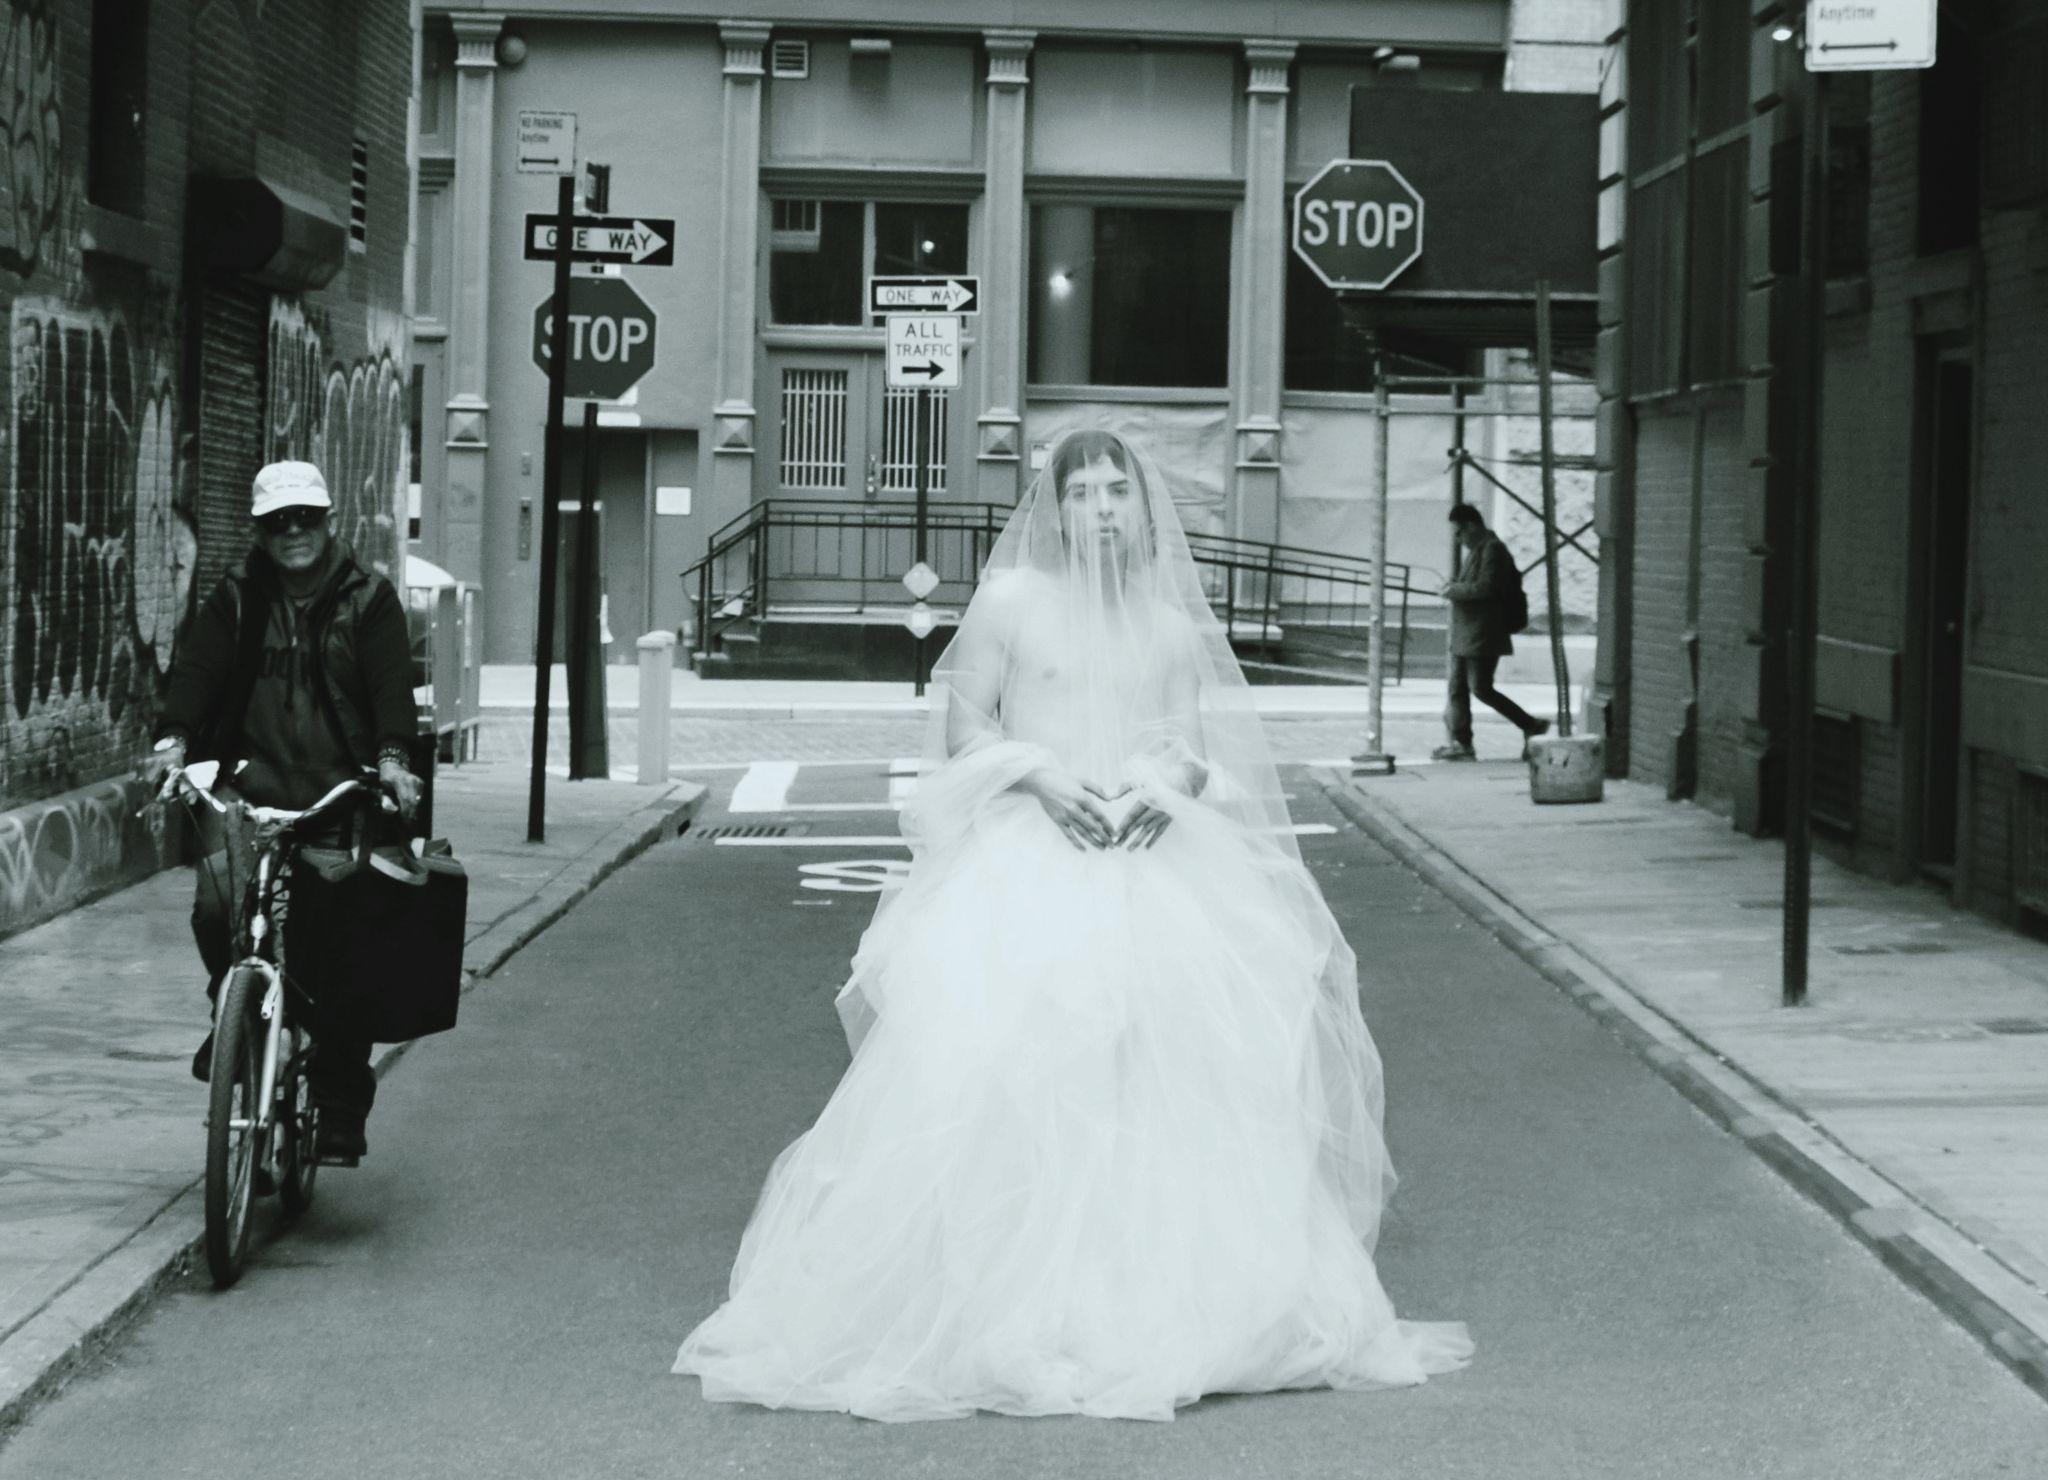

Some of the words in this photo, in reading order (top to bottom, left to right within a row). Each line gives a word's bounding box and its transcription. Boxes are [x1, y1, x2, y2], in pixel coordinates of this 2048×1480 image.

[1302, 200, 1414, 249] STOP
[546, 229, 588, 249] OE
[608, 232, 653, 251] WAY
[886, 289, 915, 303] ONE
[930, 289, 962, 302] WAY
[905, 322, 943, 339] ALL
[895, 343, 954, 357] TRAFFIC
